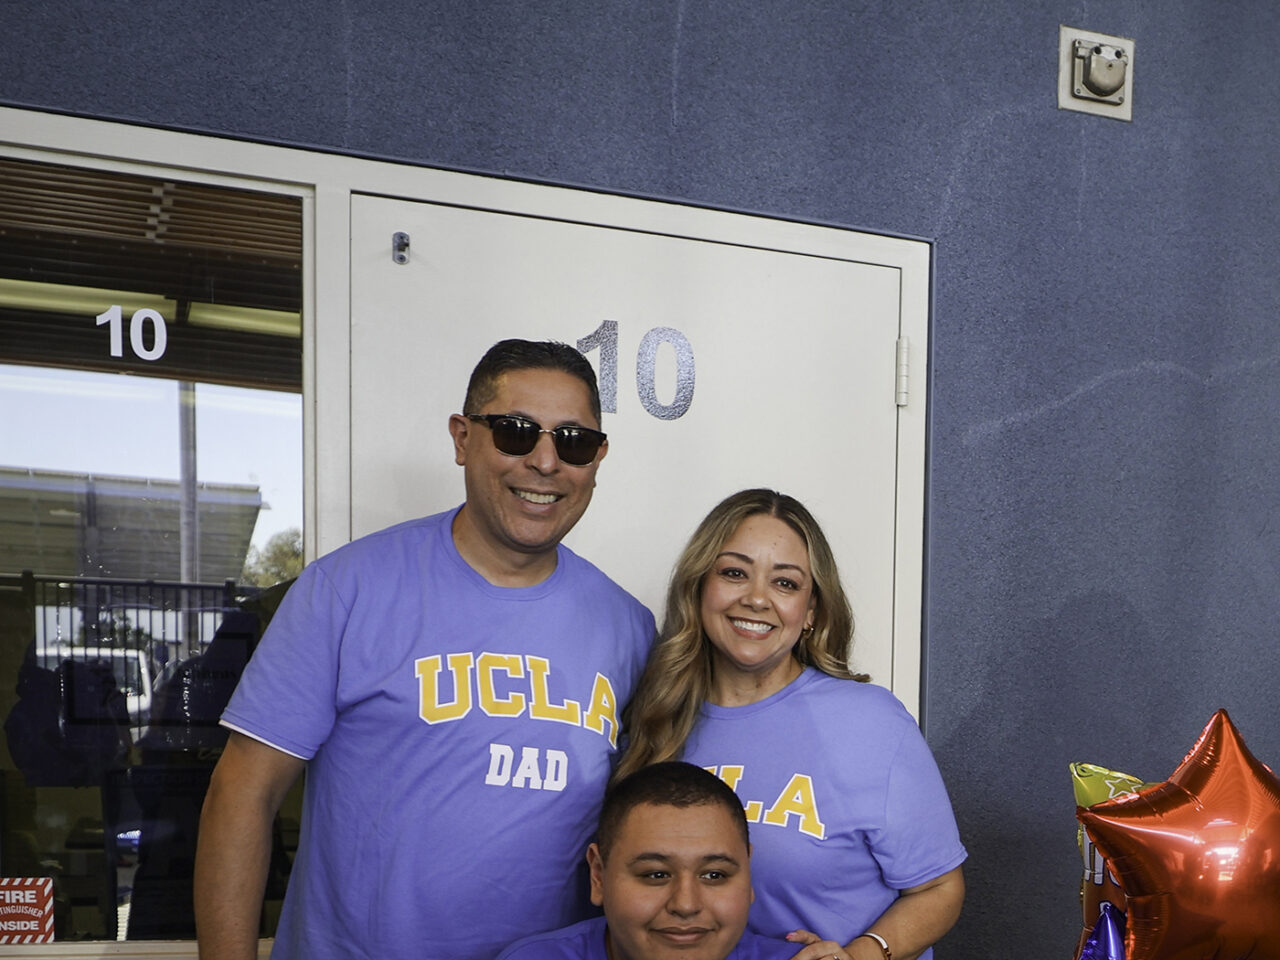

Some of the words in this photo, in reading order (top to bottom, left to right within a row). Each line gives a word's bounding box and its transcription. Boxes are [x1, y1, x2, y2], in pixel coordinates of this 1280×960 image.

[96, 305, 168, 361] 10
[576, 319, 696, 421] 10
[415, 652, 618, 749] UCLA
[485, 744, 568, 792] DAD
[703, 765, 826, 841] LA
